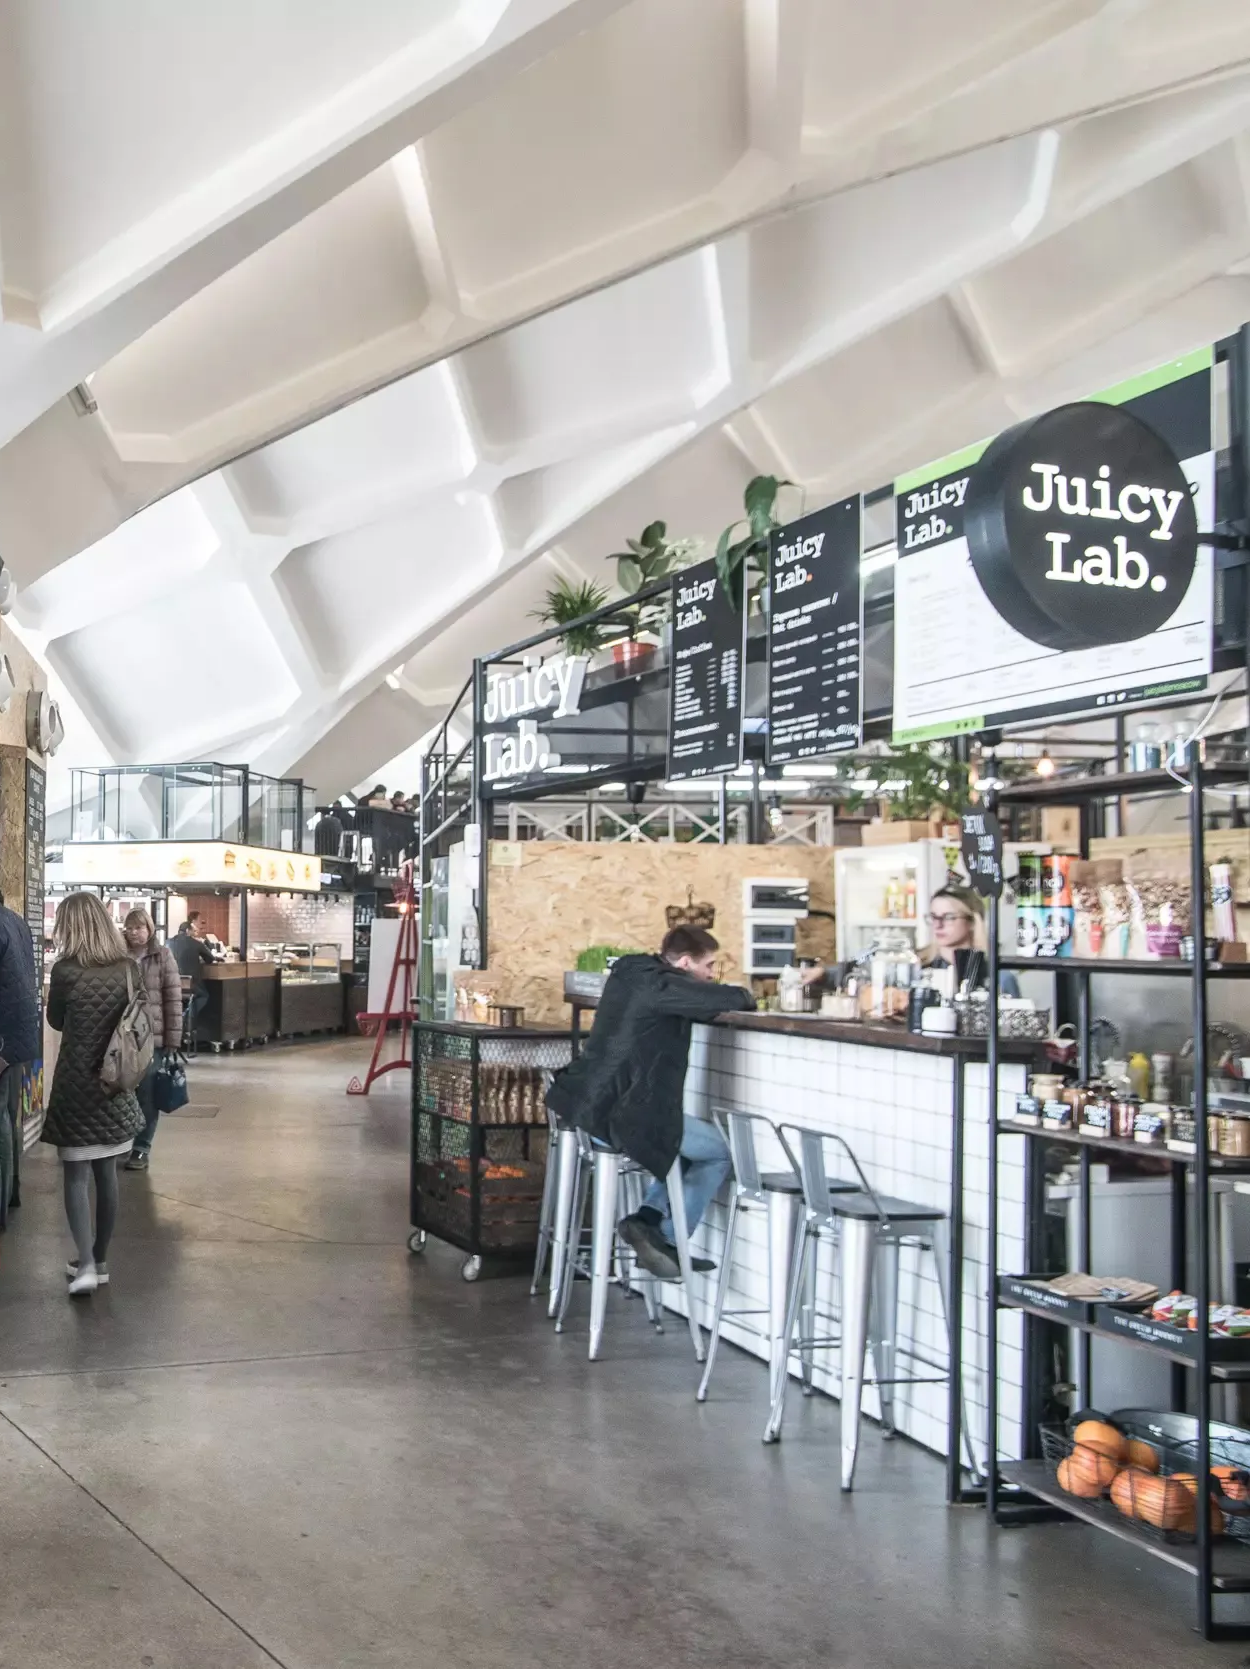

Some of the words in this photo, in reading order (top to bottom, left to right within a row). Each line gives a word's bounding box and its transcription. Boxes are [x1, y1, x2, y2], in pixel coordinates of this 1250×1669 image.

[904, 477, 970, 519] Juicy
[1023, 463, 1184, 541] Juicy
[775, 532, 825, 567] Juicy
[904, 515, 953, 549] Lab.
[774, 563, 813, 593] Lab.
[1045, 532, 1167, 592] Lab.
[676, 579, 717, 608] Juicy
[676, 605, 707, 631] Lab.
[483, 655, 584, 723] Juicy
[483, 719, 554, 781] Lab.
